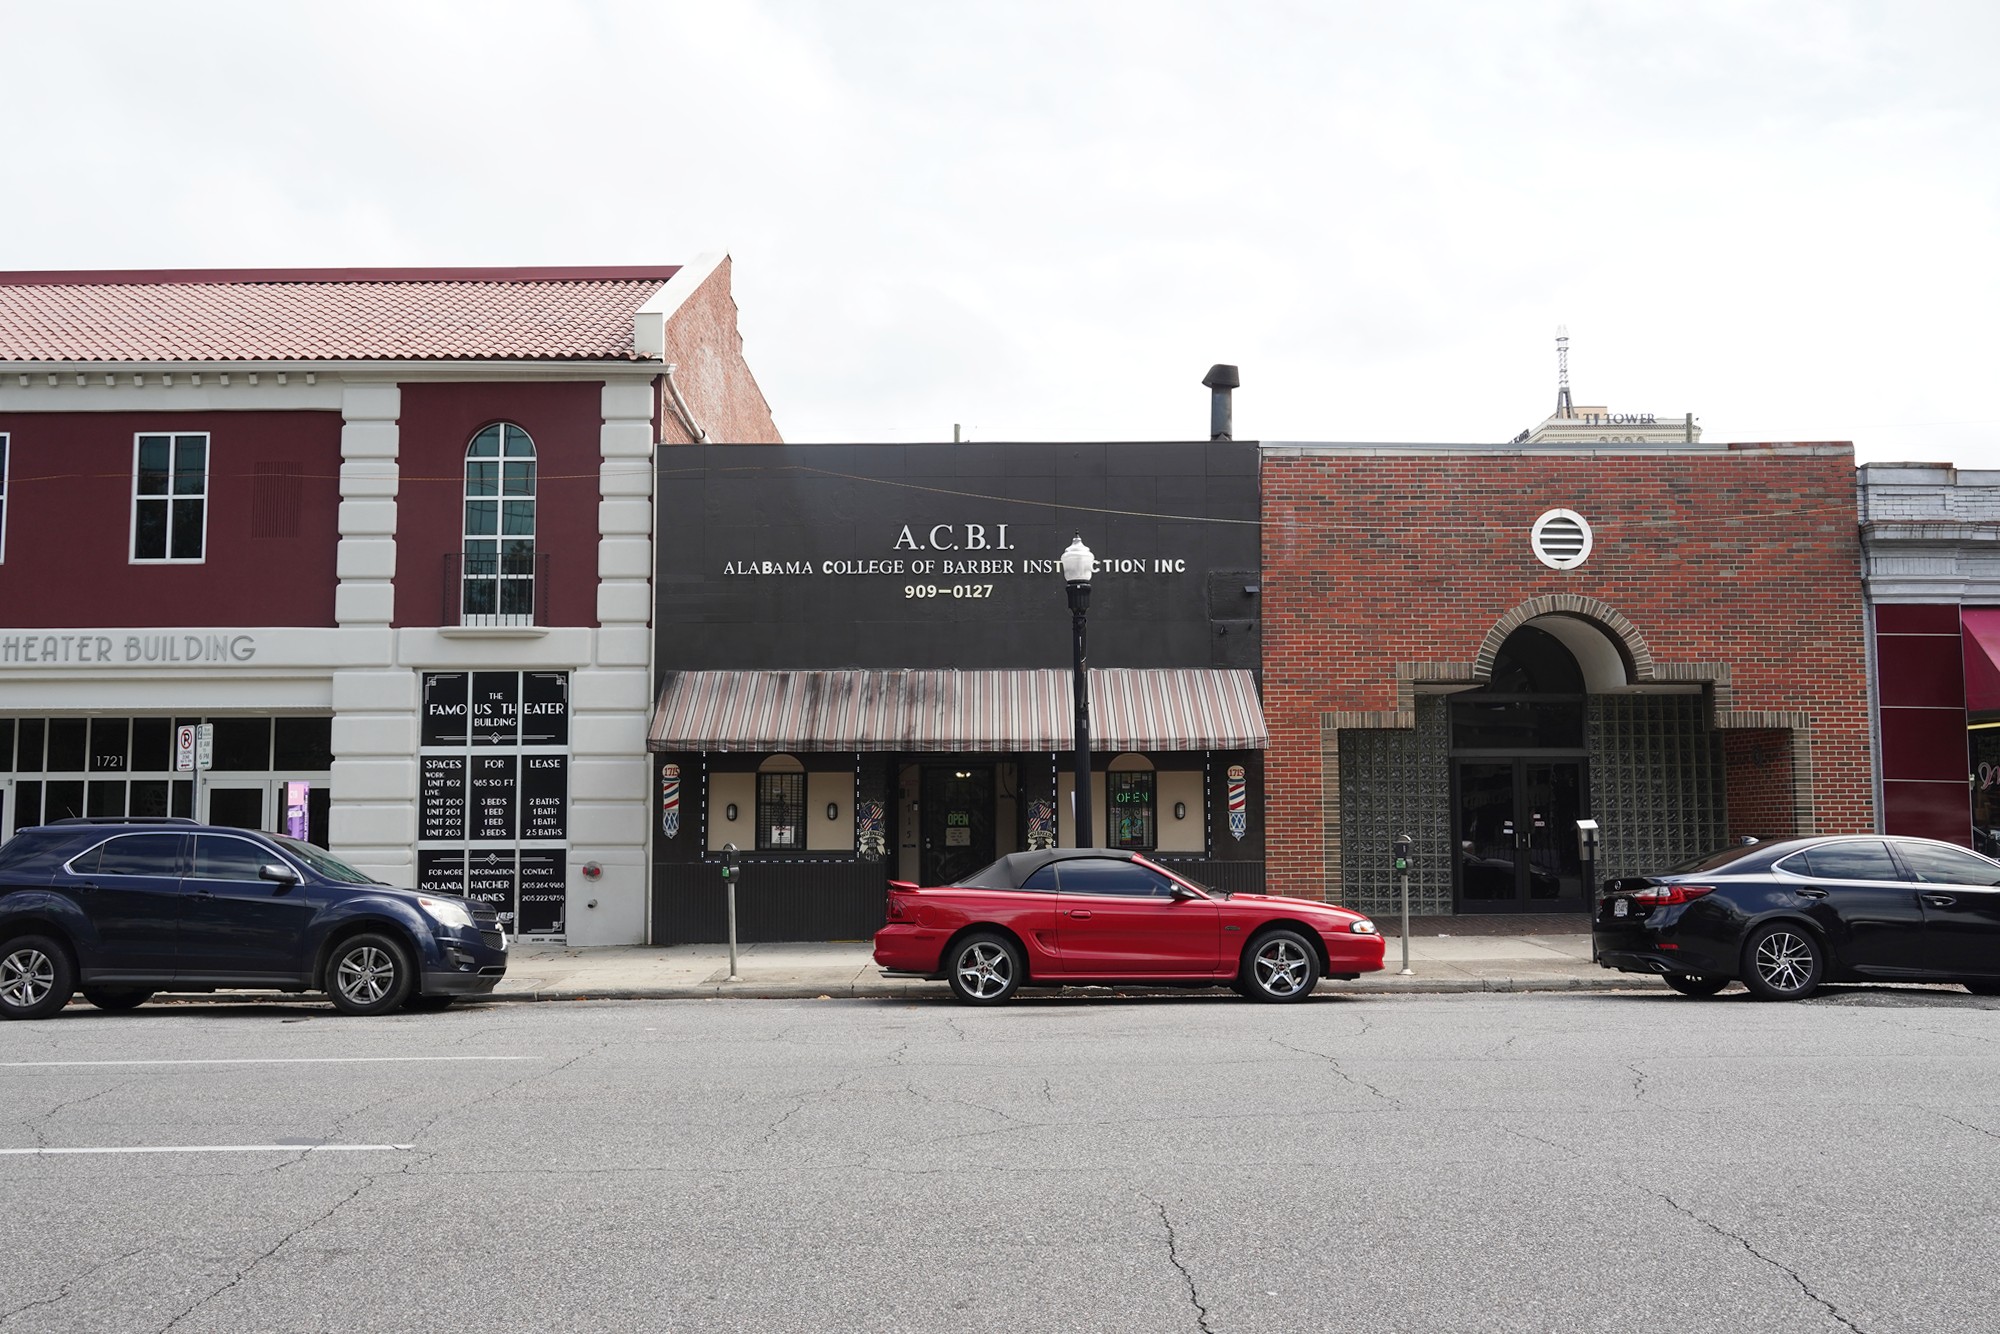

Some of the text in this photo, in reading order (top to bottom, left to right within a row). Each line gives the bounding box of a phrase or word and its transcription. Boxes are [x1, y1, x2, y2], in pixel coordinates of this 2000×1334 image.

[1583, 413, 1657, 425] TJ TOWER
[723, 558, 1186, 575] ALABAMA COLLEGE OF BARBER INSTCTION INC
[904, 584, 994, 599] 909-0127
[2, 635, 257, 662] HEATER BUILDING
[489, 692, 503, 700] THE
[474, 718, 517, 727] BUILDING
[97, 755, 123, 767] 1721
[425, 759, 561, 769] SPACES FOR LEASE
[1229, 769, 1244, 777] 1715
[427, 798, 444, 806] UNIT
[445, 798, 464, 806] 200
[480, 798, 486, 806] 3
[487, 798, 507, 806] BEDS
[529, 798, 535, 806] 2
[1116, 792, 1148, 803] OPEN
[426, 808, 444, 816] UNIT
[445, 808, 460, 816] 201
[489, 808, 504, 816] BED
[426, 818, 444, 826] UNIT
[445, 818, 462, 826] 202
[489, 818, 504, 826] BED
[947, 813, 969, 826] OPEN
[469, 868, 515, 876] INFORMATION
[421, 882, 463, 890] NOLANDA
[470, 880, 510, 889] HATCHER
[470, 892, 505, 902] BARNES
